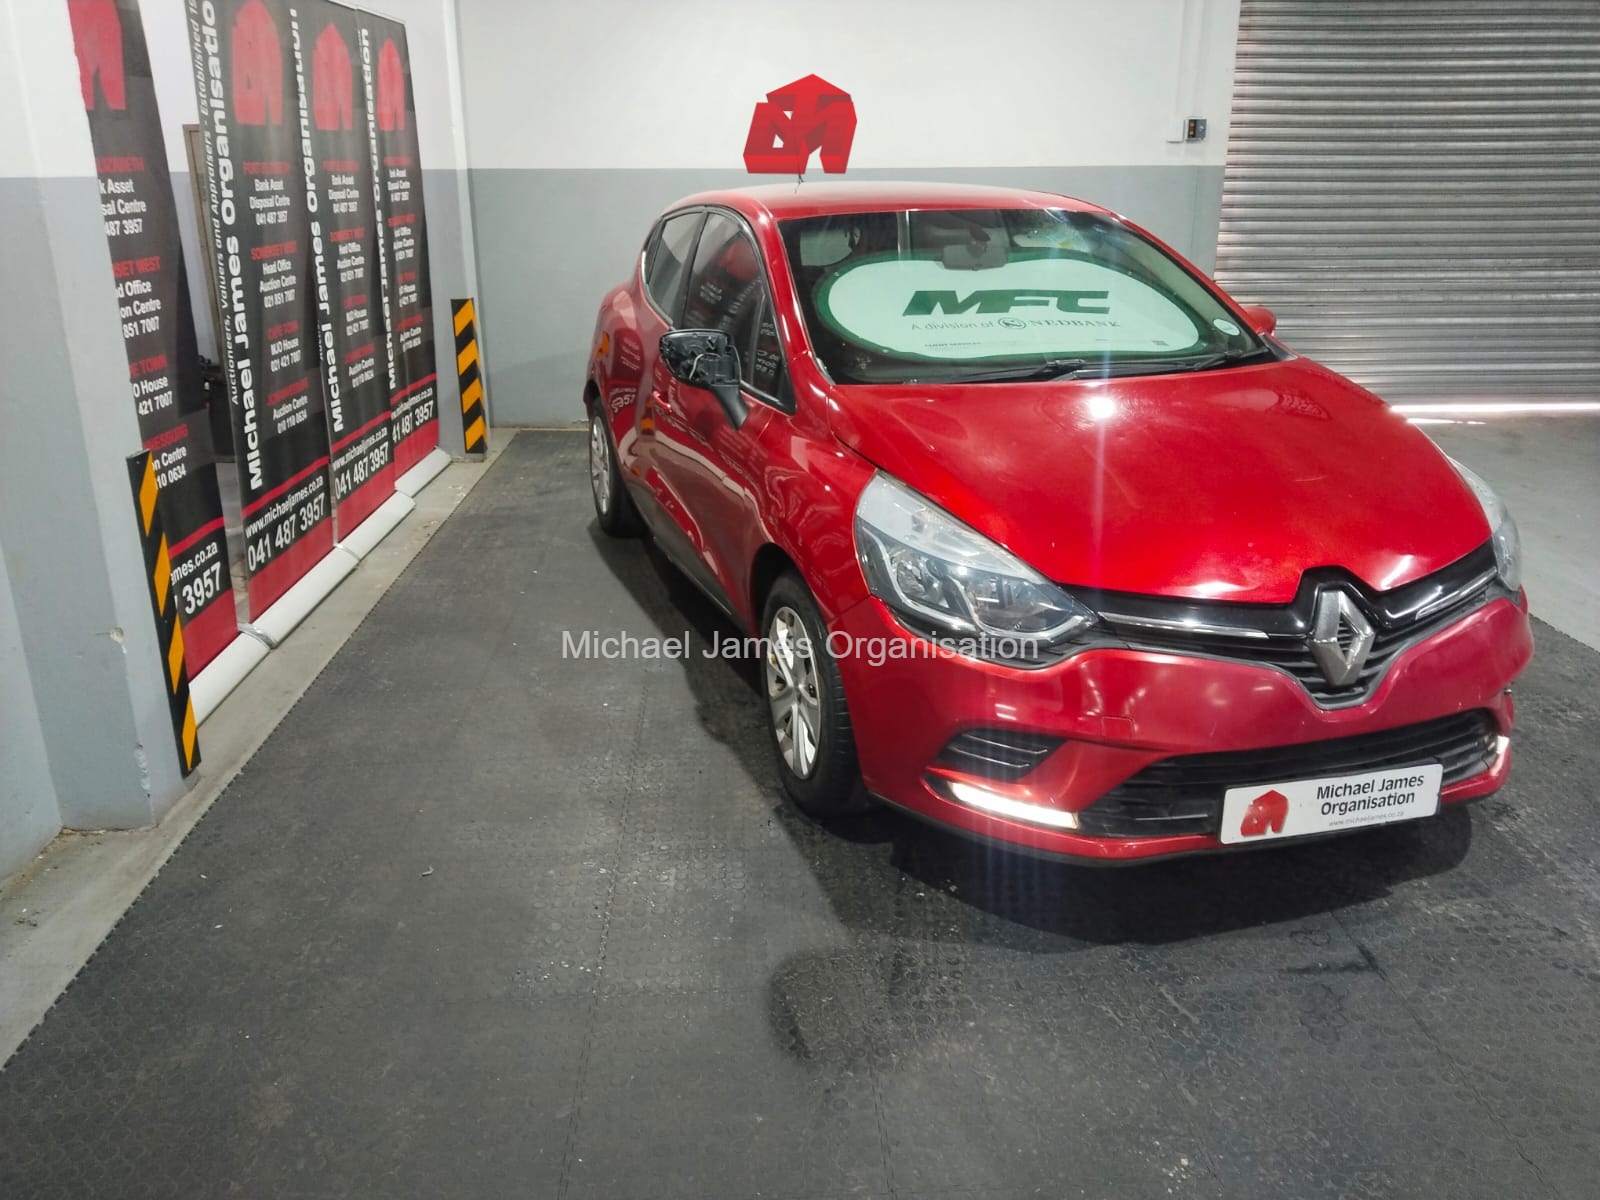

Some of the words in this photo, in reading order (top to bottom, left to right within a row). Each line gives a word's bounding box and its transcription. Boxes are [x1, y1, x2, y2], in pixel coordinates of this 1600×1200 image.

[190, 18, 208, 116] Established
[107, 178, 135, 194] Asset
[203, 130, 219, 215] Appraisers
[117, 198, 147, 214] Centre
[212, 218, 223, 249] and
[125, 280, 152, 297] Office
[217, 253, 229, 308] Valuers
[311, 221, 330, 315] James
[133, 298, 161, 315] Centre
[226, 235, 249, 349] James
[903, 289, 1110, 316] MFC
[224, 315, 239, 405] Auctioneers,
[321, 323, 344, 432] Michael
[140, 376, 169, 395] House
[237, 358, 262, 490] Michael
[415, 400, 434, 427] 3957
[161, 446, 187, 467] Centre
[353, 457, 368, 485] 487
[369, 441, 389, 472] 3957
[245, 475, 324, 539] www.michaeljames.co.za
[248, 533, 271, 572] 041
[275, 514, 296, 549] 487
[300, 492, 325, 531] 3957
[182, 561, 221, 614] 3957
[1316, 779, 1375, 800] Michael
[1378, 775, 1424, 792] James
[1320, 791, 1415, 816] Organisation
